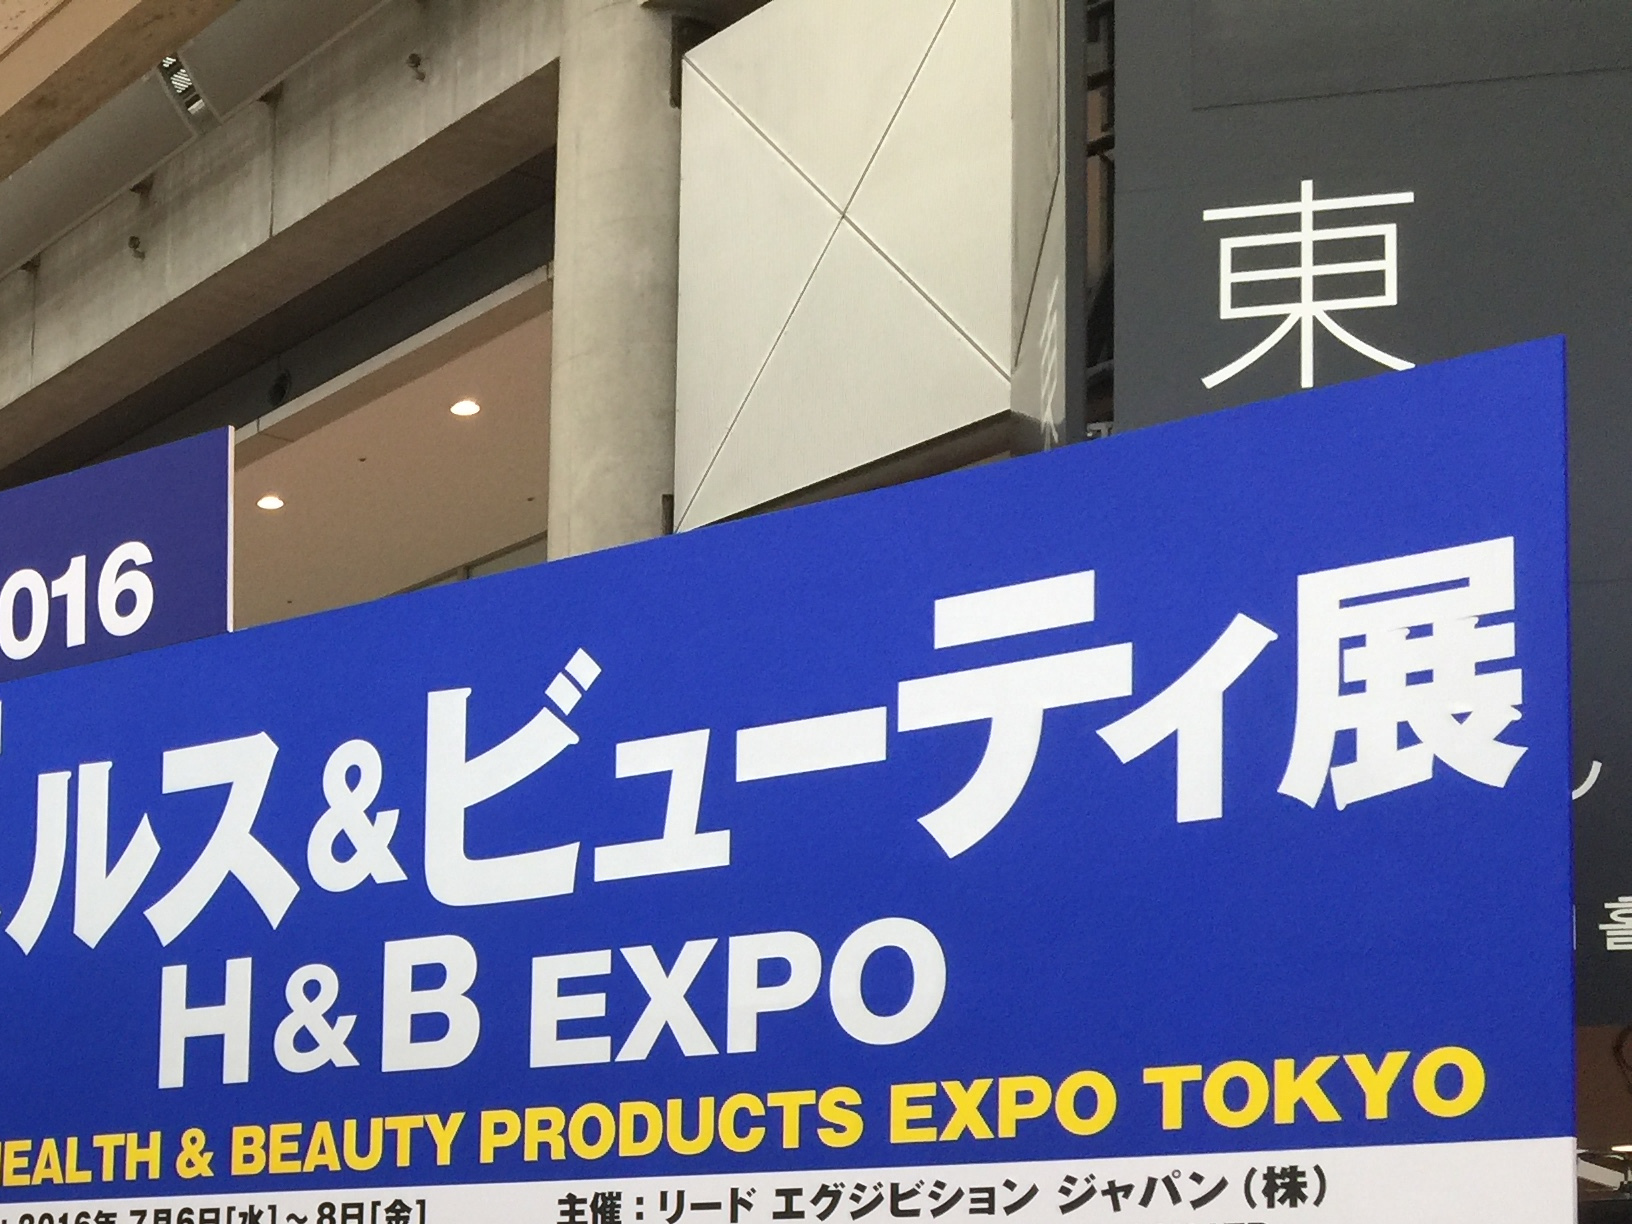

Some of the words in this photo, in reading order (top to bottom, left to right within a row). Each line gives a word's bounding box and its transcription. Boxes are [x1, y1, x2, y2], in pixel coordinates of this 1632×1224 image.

[1201, 179, 1416, 388] 東
[528, 916, 949, 1068] EXPO
[175, 1122, 214, 1180] &
[230, 1109, 465, 1174] BEAUTY
[478, 1085, 865, 1164] PRODUCTS
[889, 1068, 1116, 1141] EXPO
[1144, 1045, 1486, 1129] TOKYO
[772, 1178, 1039, 1221] エグジビション
